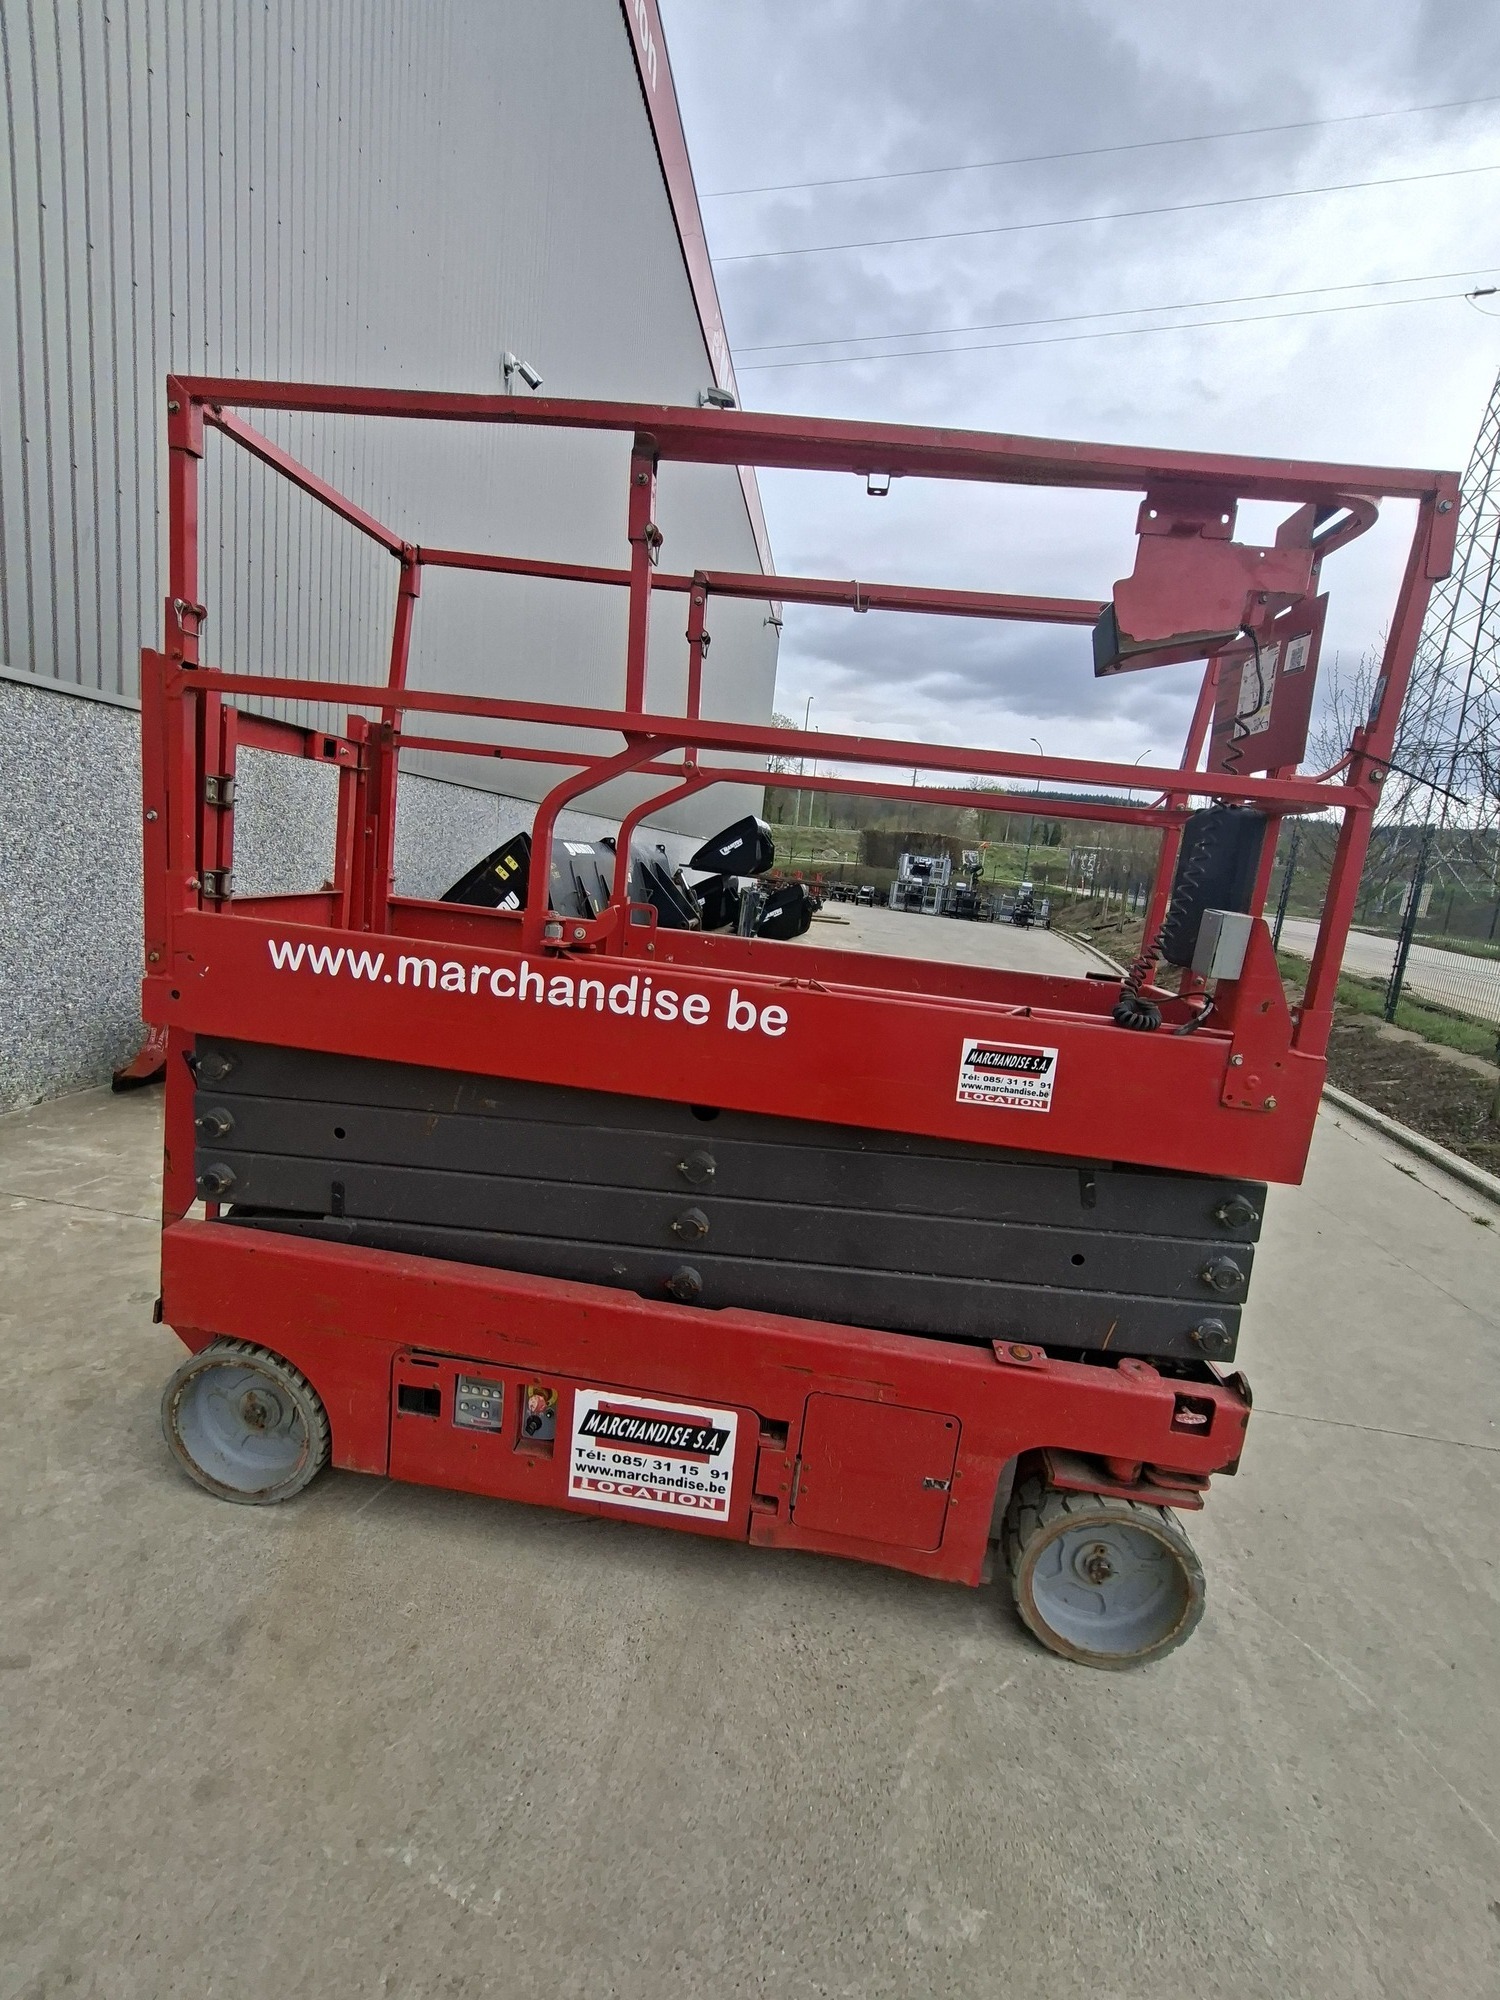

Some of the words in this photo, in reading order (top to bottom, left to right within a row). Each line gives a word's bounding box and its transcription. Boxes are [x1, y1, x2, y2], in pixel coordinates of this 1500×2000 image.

[268, 939, 711, 1025] www.marchandise
[726, 988, 790, 1037] be
[968, 1051, 1032, 1069] MARCHANDISE
[1031, 1059, 1047, 1071] S.A.
[961, 1082, 1050, 1099] www.marchandise.be
[962, 1073, 980, 1081] Tél:
[983, 1075, 1004, 1084] 085/
[964, 1091, 1043, 1108] LOCATION
[584, 1413, 693, 1446] MARCHANDISE
[693, 1430, 721, 1451] S.A.
[575, 1448, 606, 1461] Tél:
[612, 1453, 648, 1467] 085/
[653, 1460, 672, 1472] 31
[679, 1464, 699, 1476] 15
[710, 1469, 730, 1481] 91
[575, 1462, 726, 1494] www.marchandise.be
[581, 1477, 716, 1509] LOCATION
